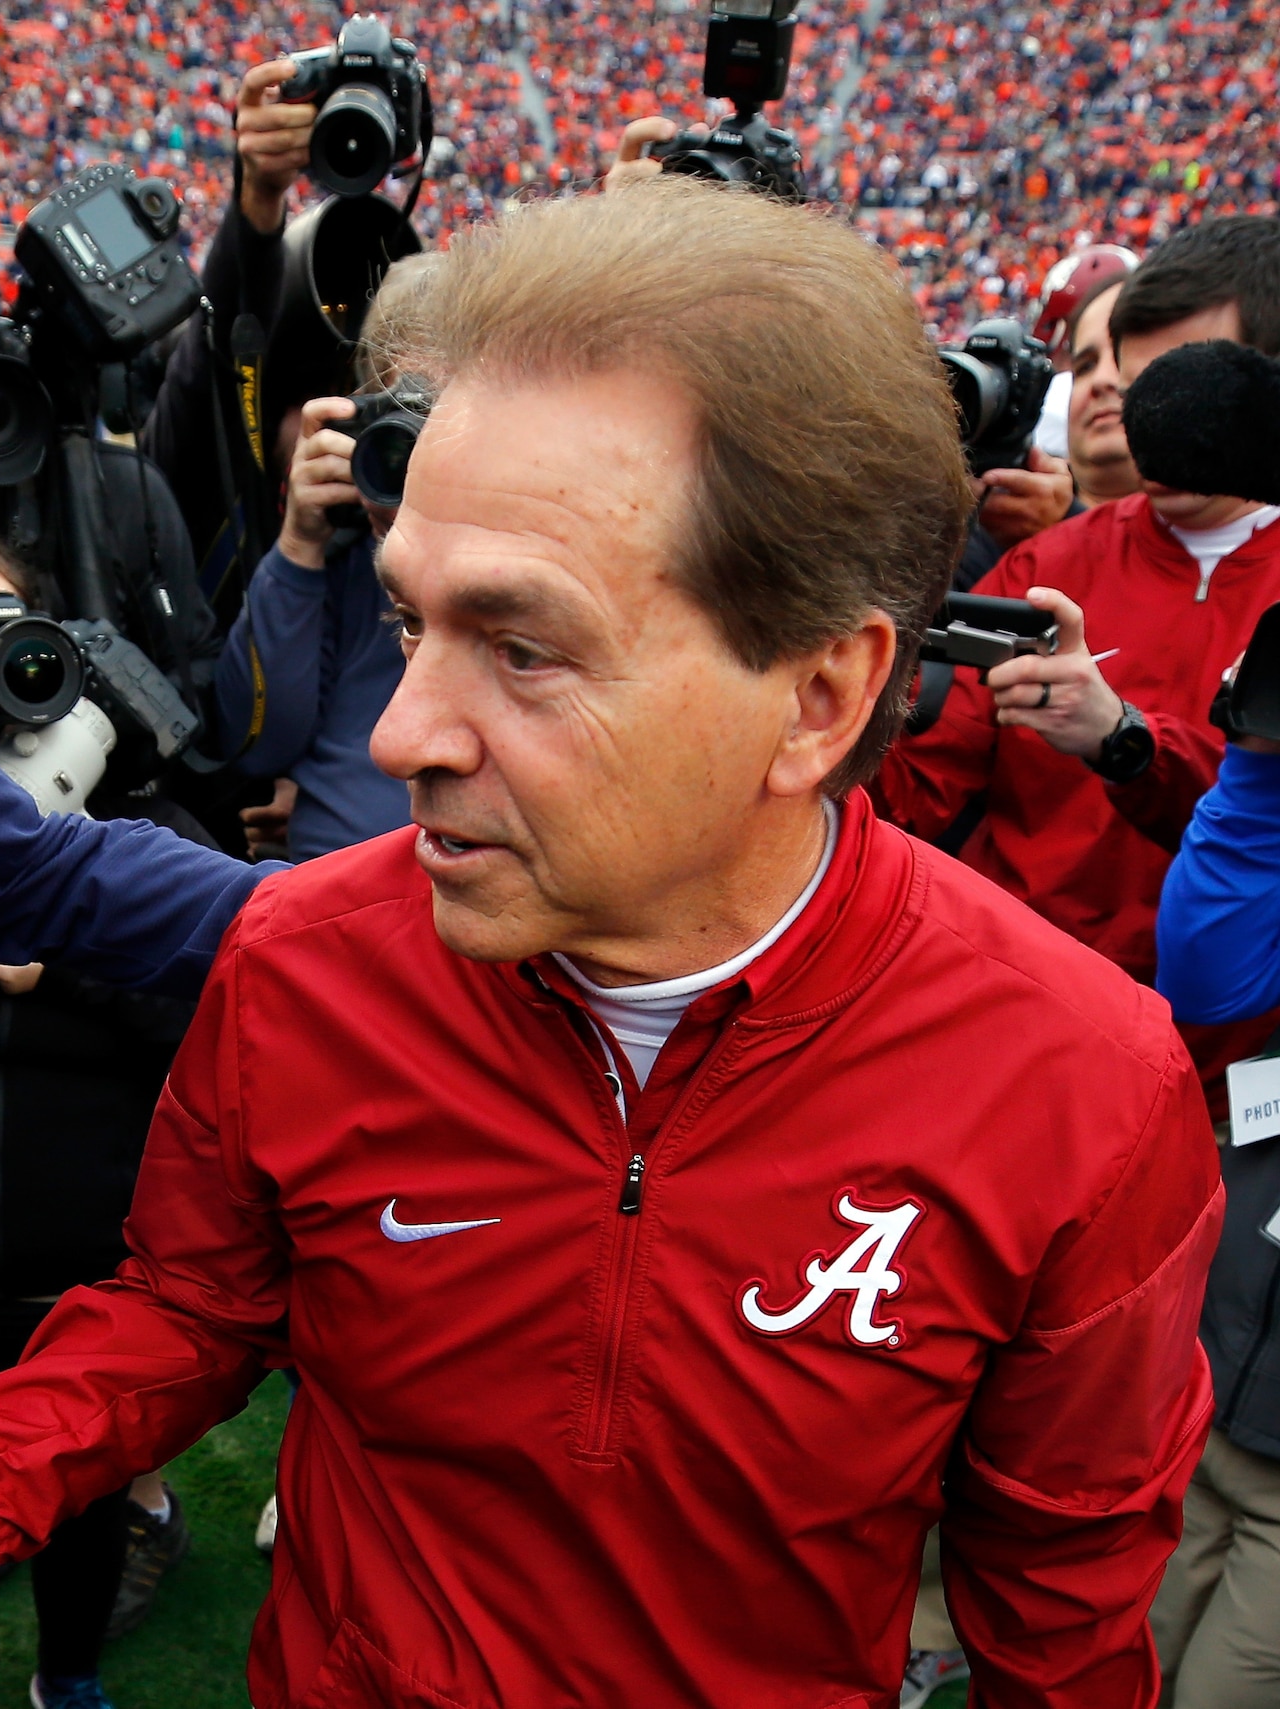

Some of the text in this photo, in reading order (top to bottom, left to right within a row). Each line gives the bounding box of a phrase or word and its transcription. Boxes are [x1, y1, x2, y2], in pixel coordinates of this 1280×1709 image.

[343, 55, 373, 66] Nikon
[713, 131, 743, 145] Nikon
[241, 365, 257, 428] Nikon
[741, 1194, 921, 1344] A
